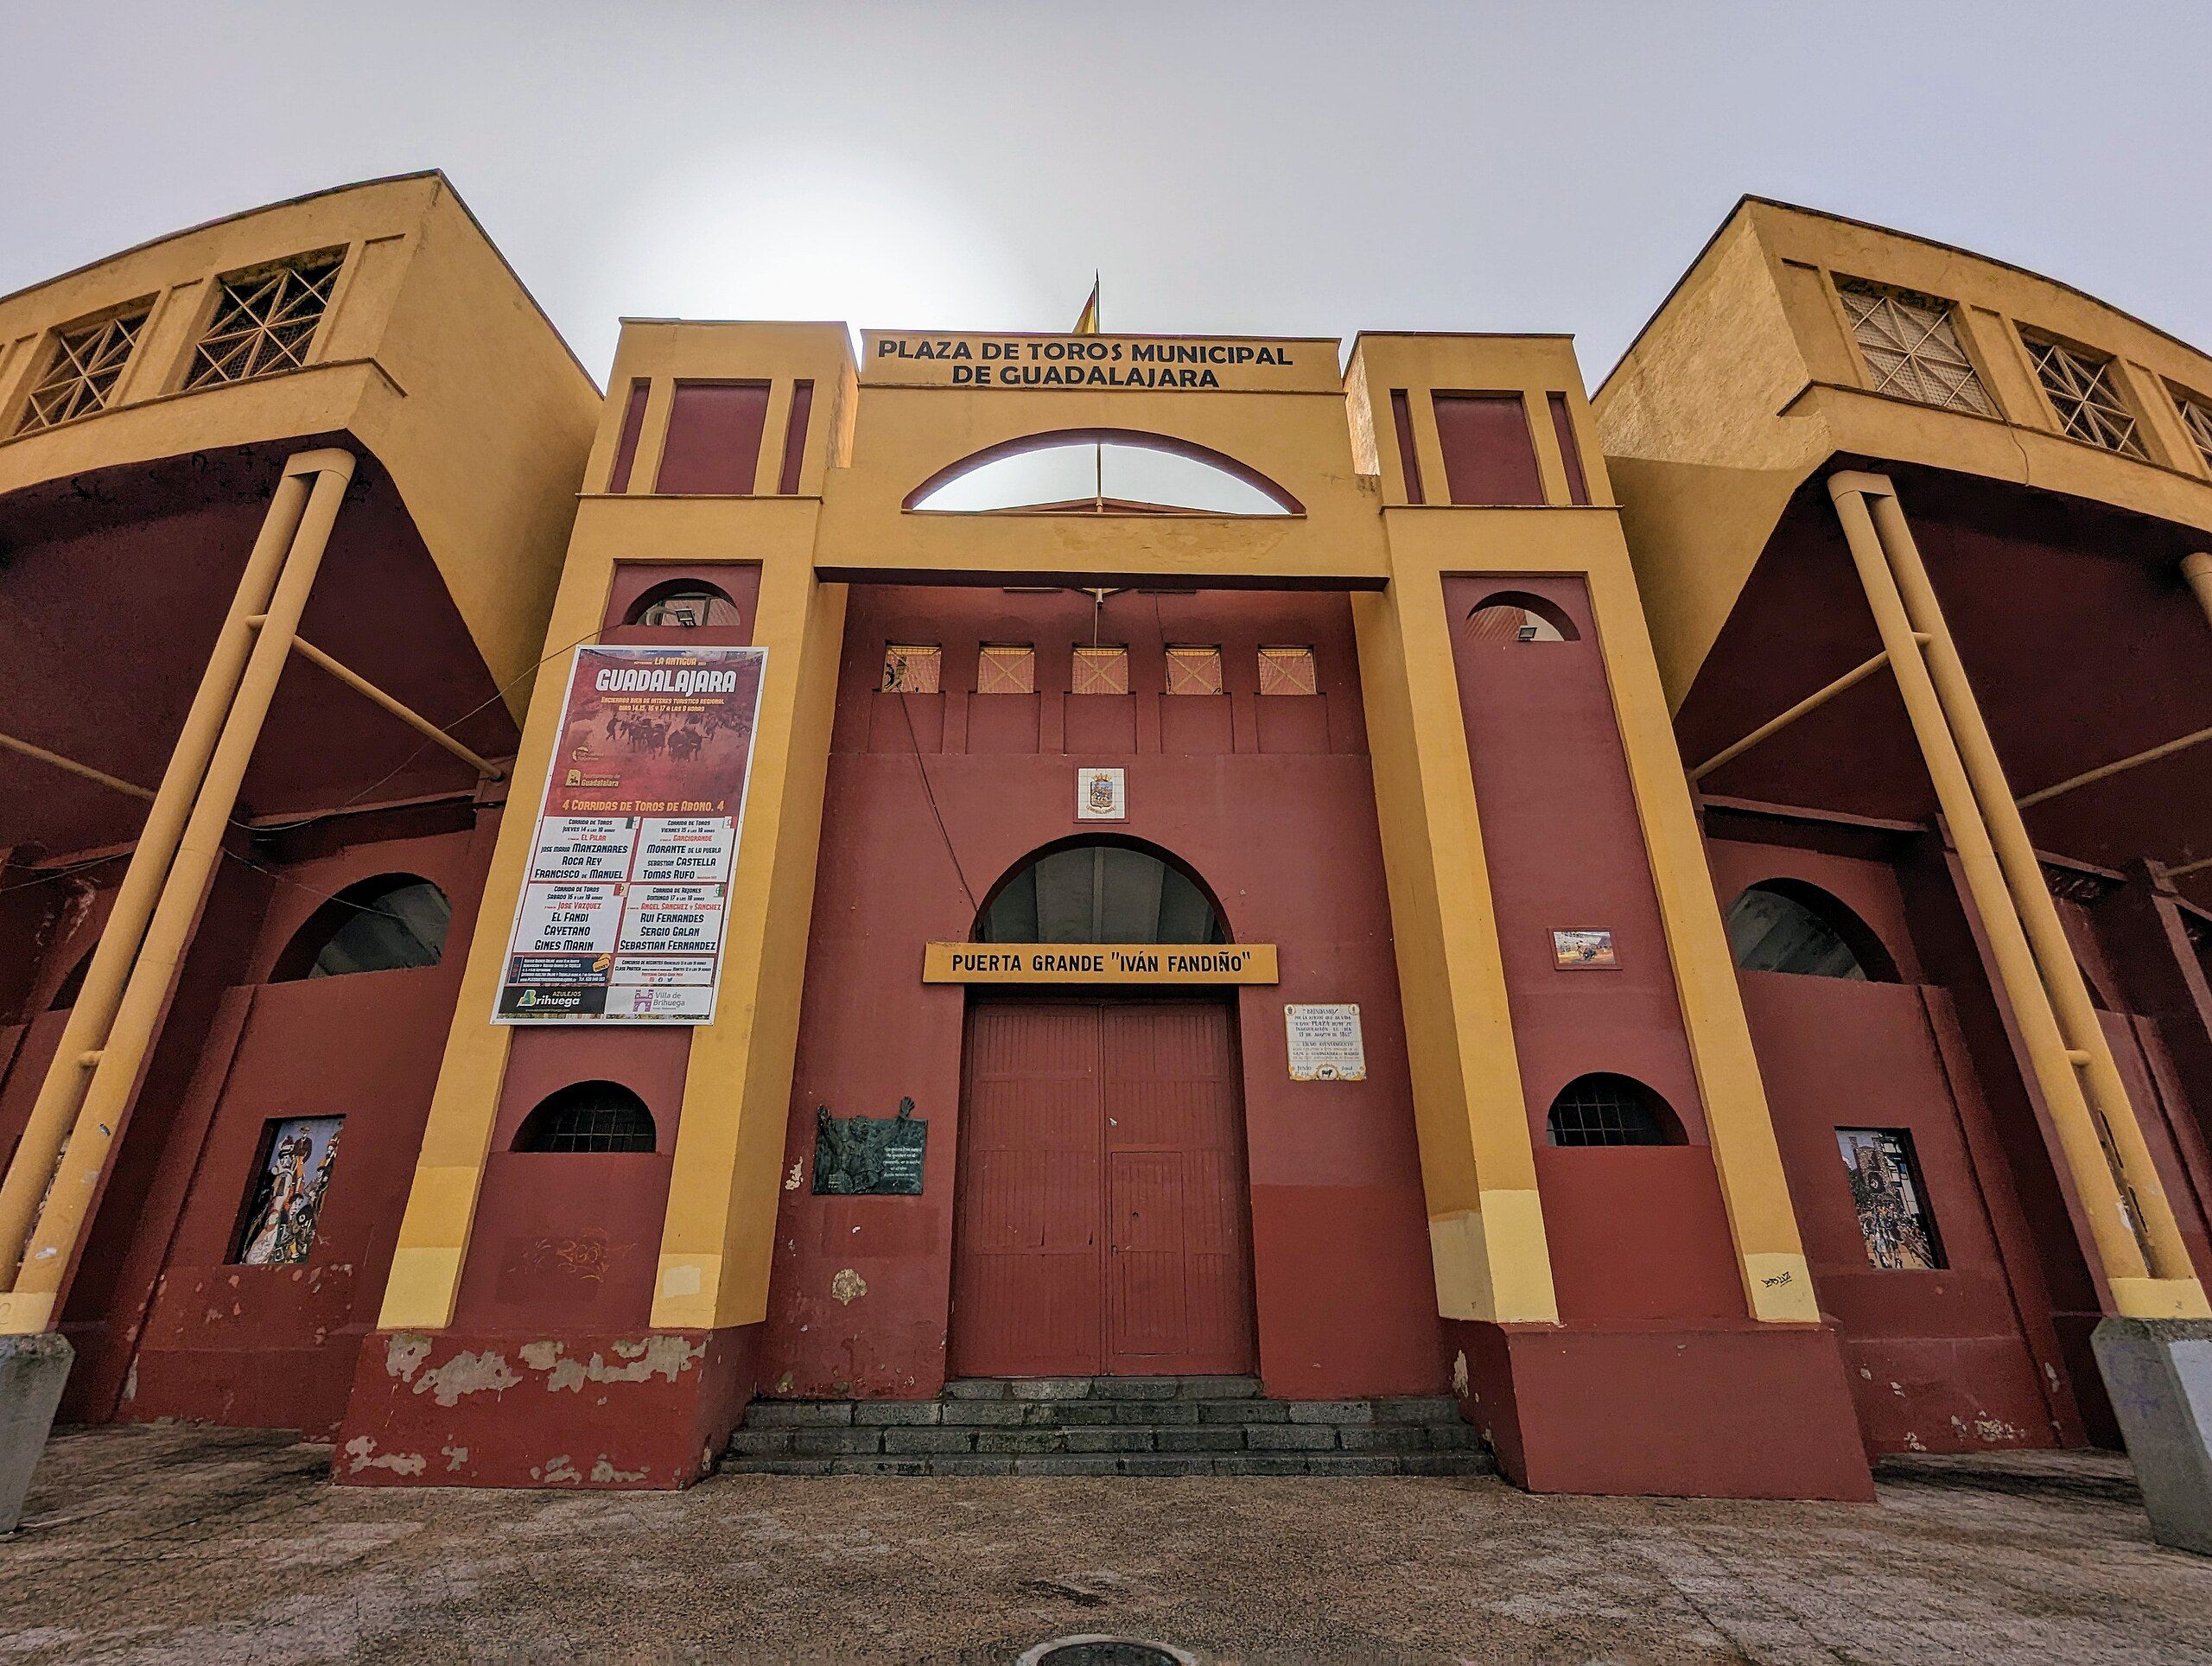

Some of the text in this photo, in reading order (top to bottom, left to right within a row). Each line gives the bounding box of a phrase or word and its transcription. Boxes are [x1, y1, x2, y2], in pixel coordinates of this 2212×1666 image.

[878, 340, 1294, 366] PLAZA DE TOROS MUNICIPAL
[952, 366, 1220, 388] DE GUADALAJARA
[595, 669, 737, 696] GUADALAJARA
[562, 800, 569, 811] 4
[571, 800, 618, 811] CORRIDAS
[620, 801, 632, 811] DE
[635, 801, 664, 811] TOROS
[666, 802, 678, 811] DE
[717, 800, 725, 811] 4
[572, 843, 628, 854] MANZANARES
[646, 844, 686, 854] MORANTE
[562, 856, 602, 866] ROCA REY
[676, 857, 716, 866] CASTELLA
[535, 868, 580, 878] FRANCISCO
[589, 869, 623, 879] MANUEL
[643, 870, 671, 879] TOMAS
[674, 870, 695, 879] RUFO
[551, 912, 589, 922] EL FANDI
[640, 913, 704, 923] RUI FERNANDES
[544, 925, 590, 936] CAYETANO
[640, 926, 700, 937] SERGIO GALAN
[534, 939, 594, 951] GINES MARIN
[620, 940, 716, 951] SEBASTIAN FERNANDEZ
[952, 951, 1251, 972] PUERTA GRANDE "IVÁN FANDIÑO"
[653, 999, 685, 1008] Brihuega
